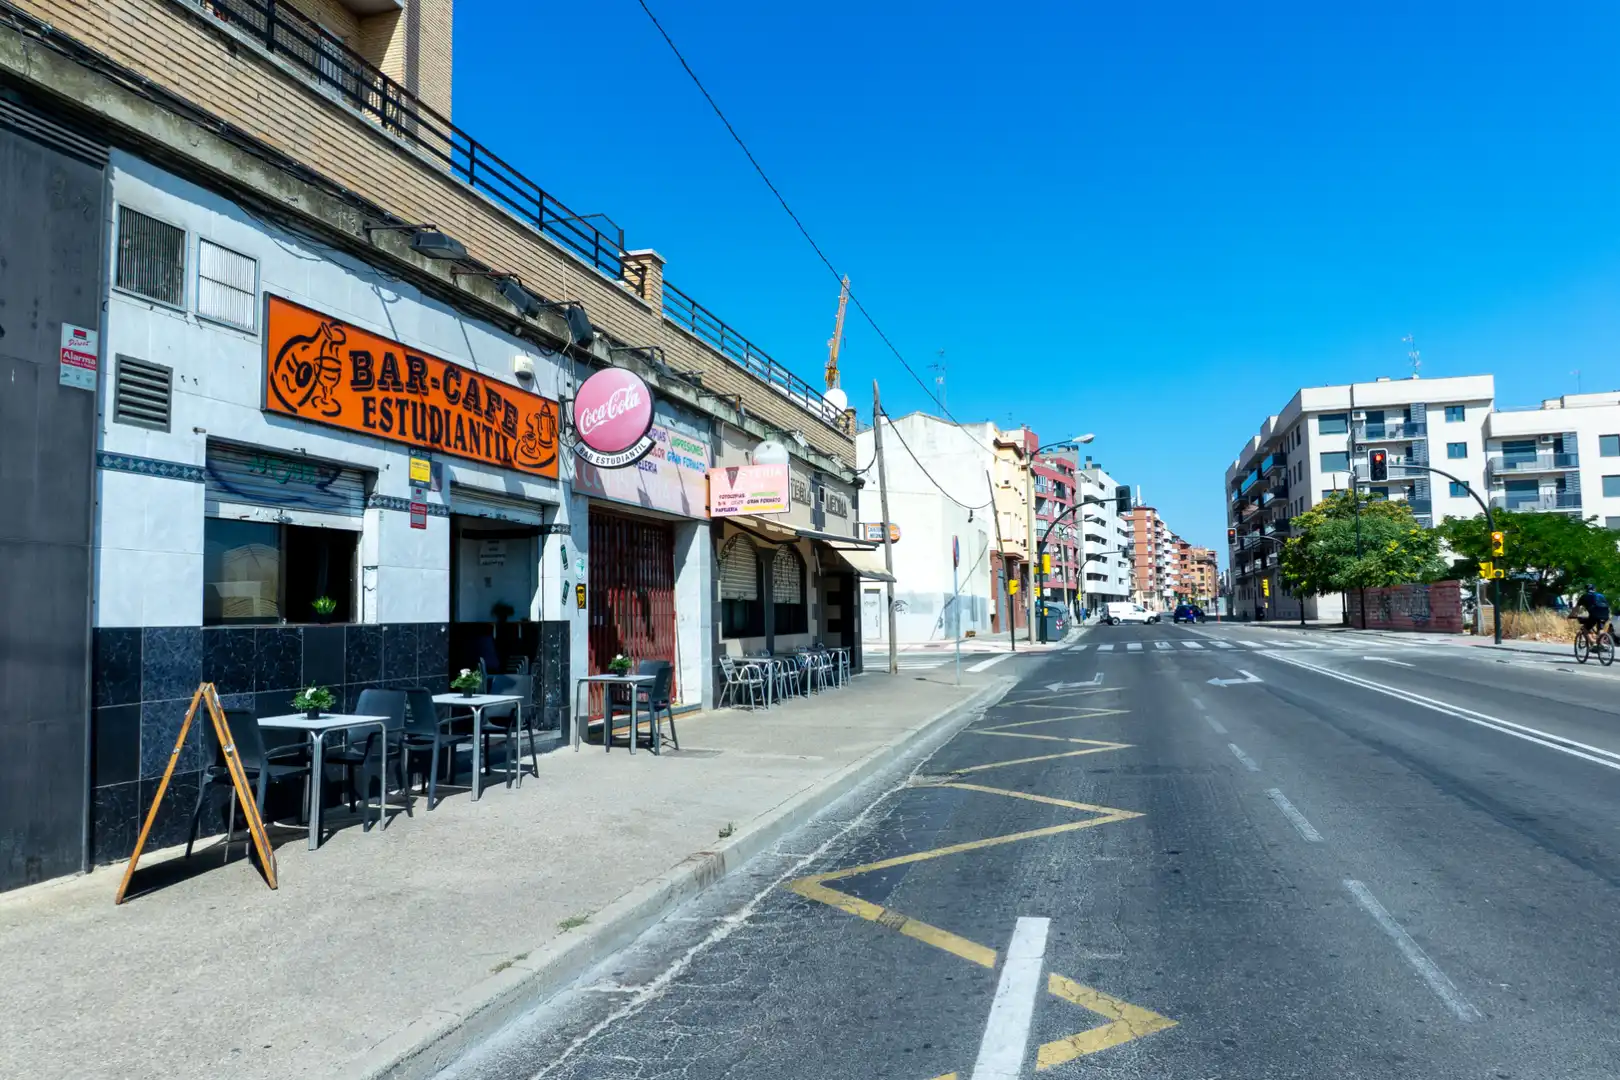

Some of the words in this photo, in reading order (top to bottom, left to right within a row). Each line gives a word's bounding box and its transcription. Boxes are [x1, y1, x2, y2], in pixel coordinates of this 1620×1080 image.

[63, 350, 96, 365] Alarma
[350, 350, 518, 440] BAR-CAFE
[580, 383, 641, 435] Coca-Cola
[362, 396, 511, 462] ESTUDIANTIL
[579, 446, 594, 461] BAR
[595, 443, 647, 465] ESTUDIANTIL
